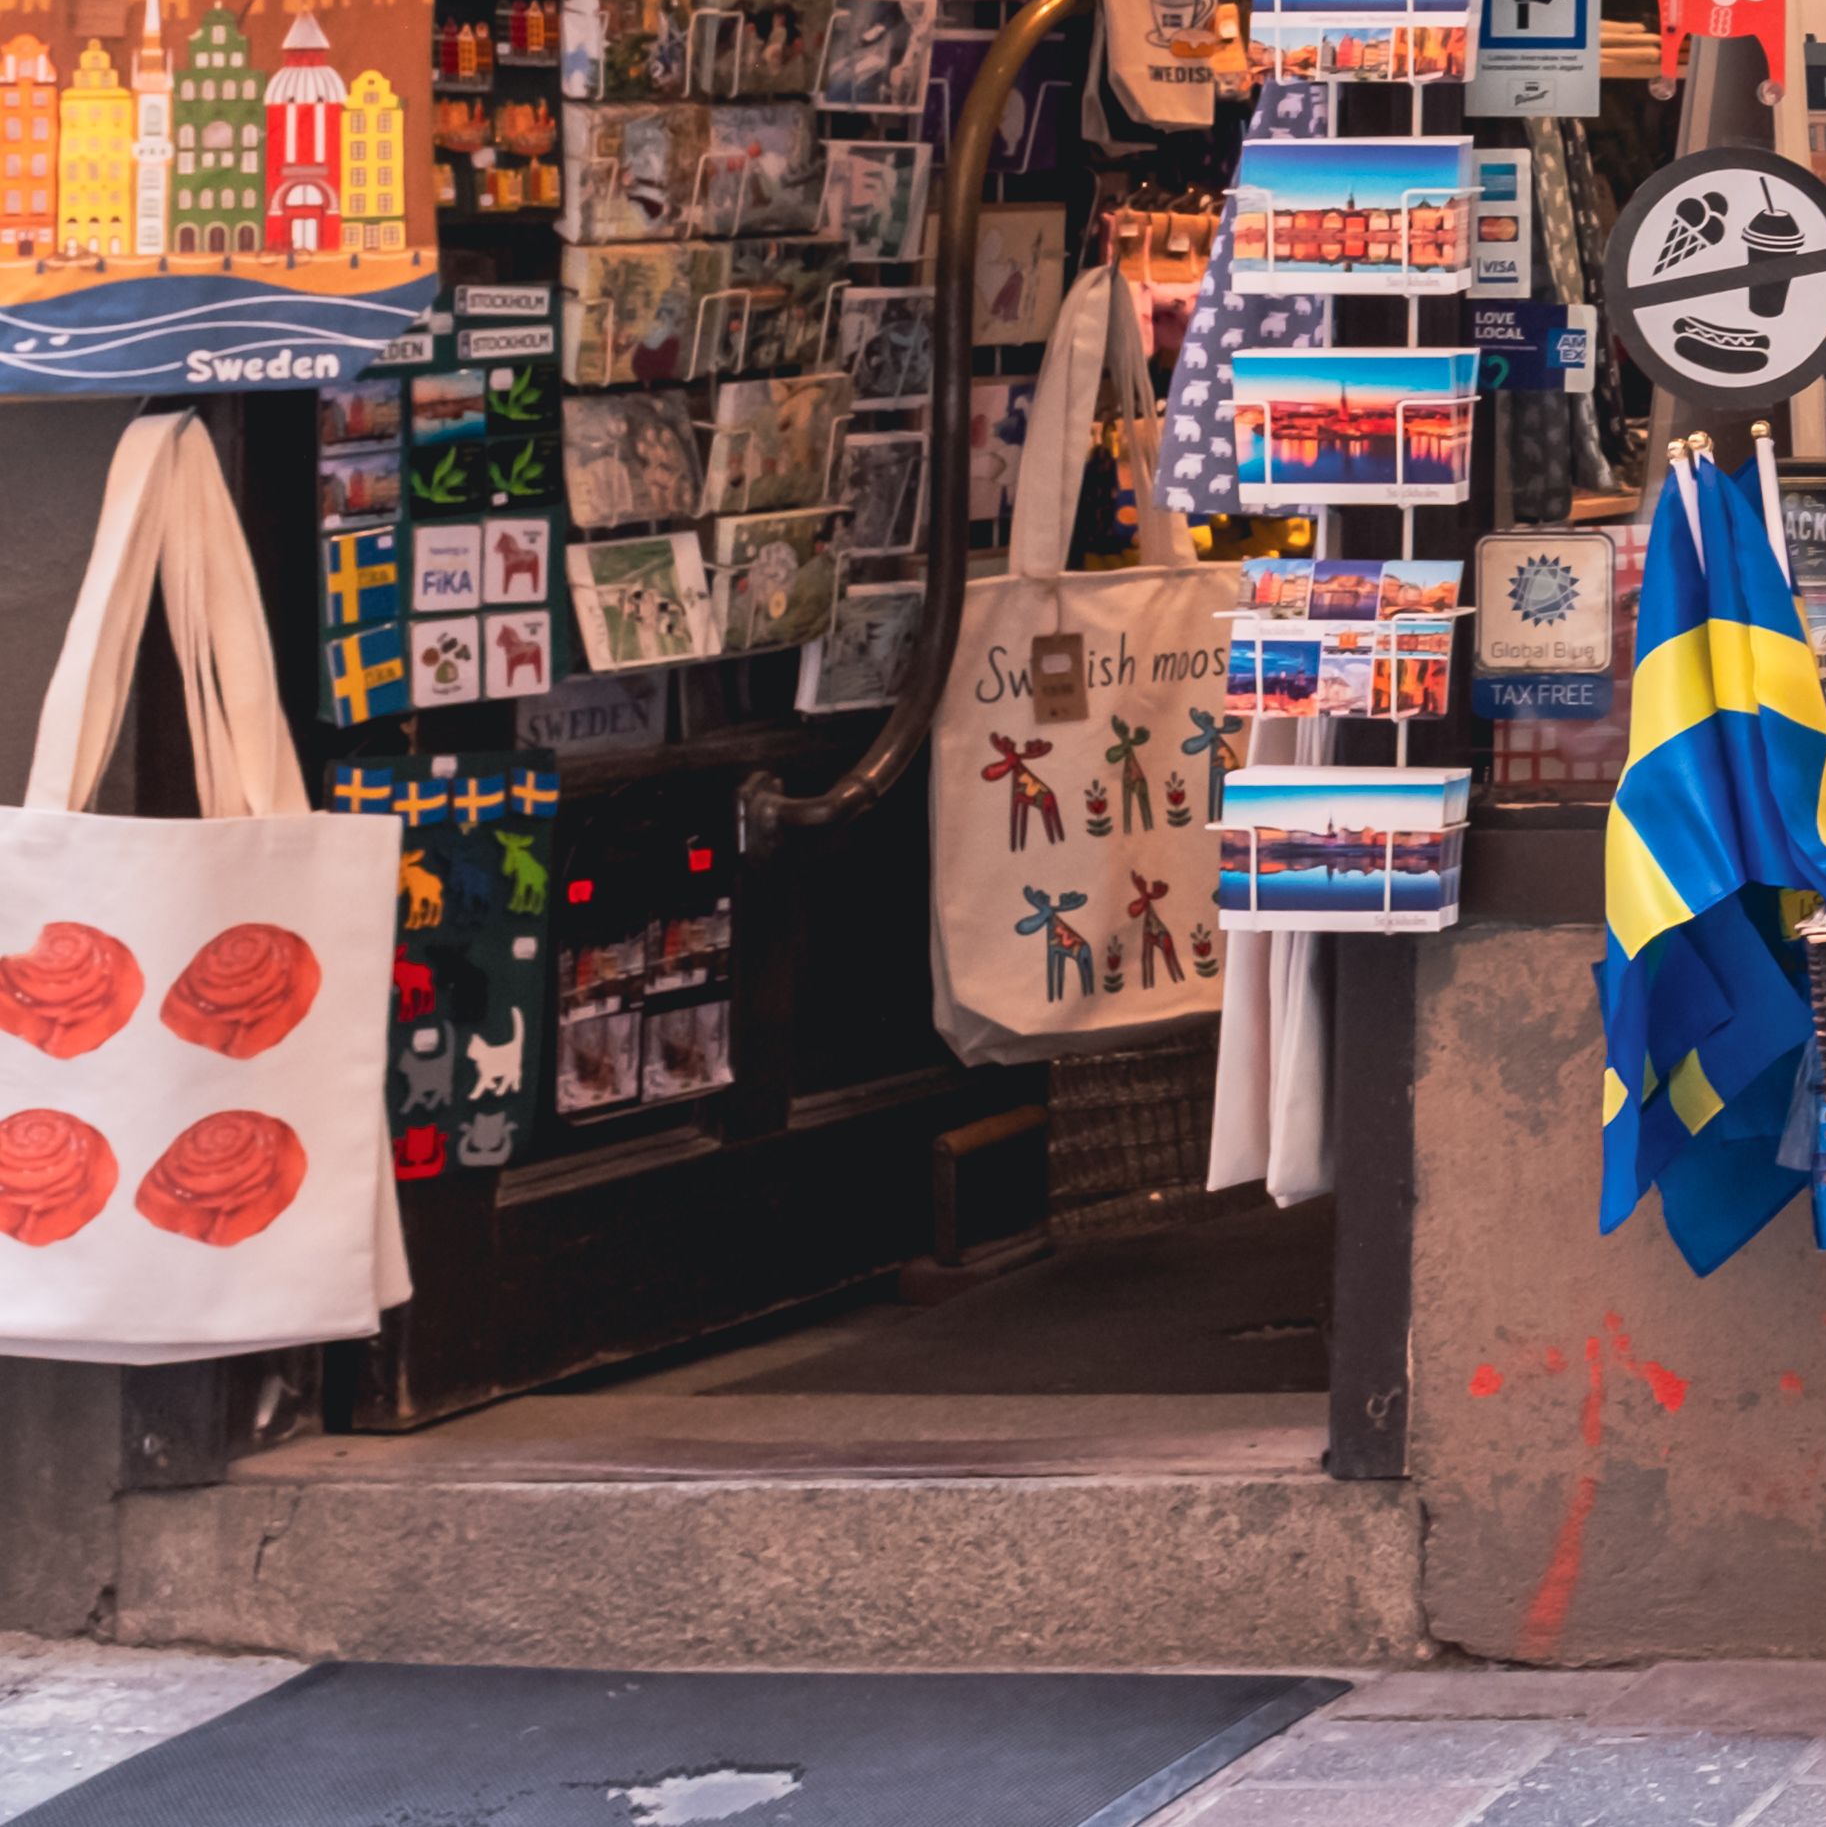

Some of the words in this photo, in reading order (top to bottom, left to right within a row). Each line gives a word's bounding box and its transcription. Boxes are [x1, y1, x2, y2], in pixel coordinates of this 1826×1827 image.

[1483, 260, 1517, 274] VISA
[467, 293, 547, 311] STOCKHOLM
[1475, 311, 1516, 325] LOVE
[472, 333, 552, 353] STOCKHOLM
[1475, 327, 1525, 340] LOCAL
[186, 349, 341, 383] Sweden
[1490, 640, 1550, 659] Global
[1553, 640, 1595, 661] Blue
[975, 633, 1137, 704] Swish
[1150, 646, 1228, 684] moos
[1490, 684, 1533, 705] TAX
[1537, 684, 1594, 705] FREE
[530, 703, 652, 744] SWEDEN
